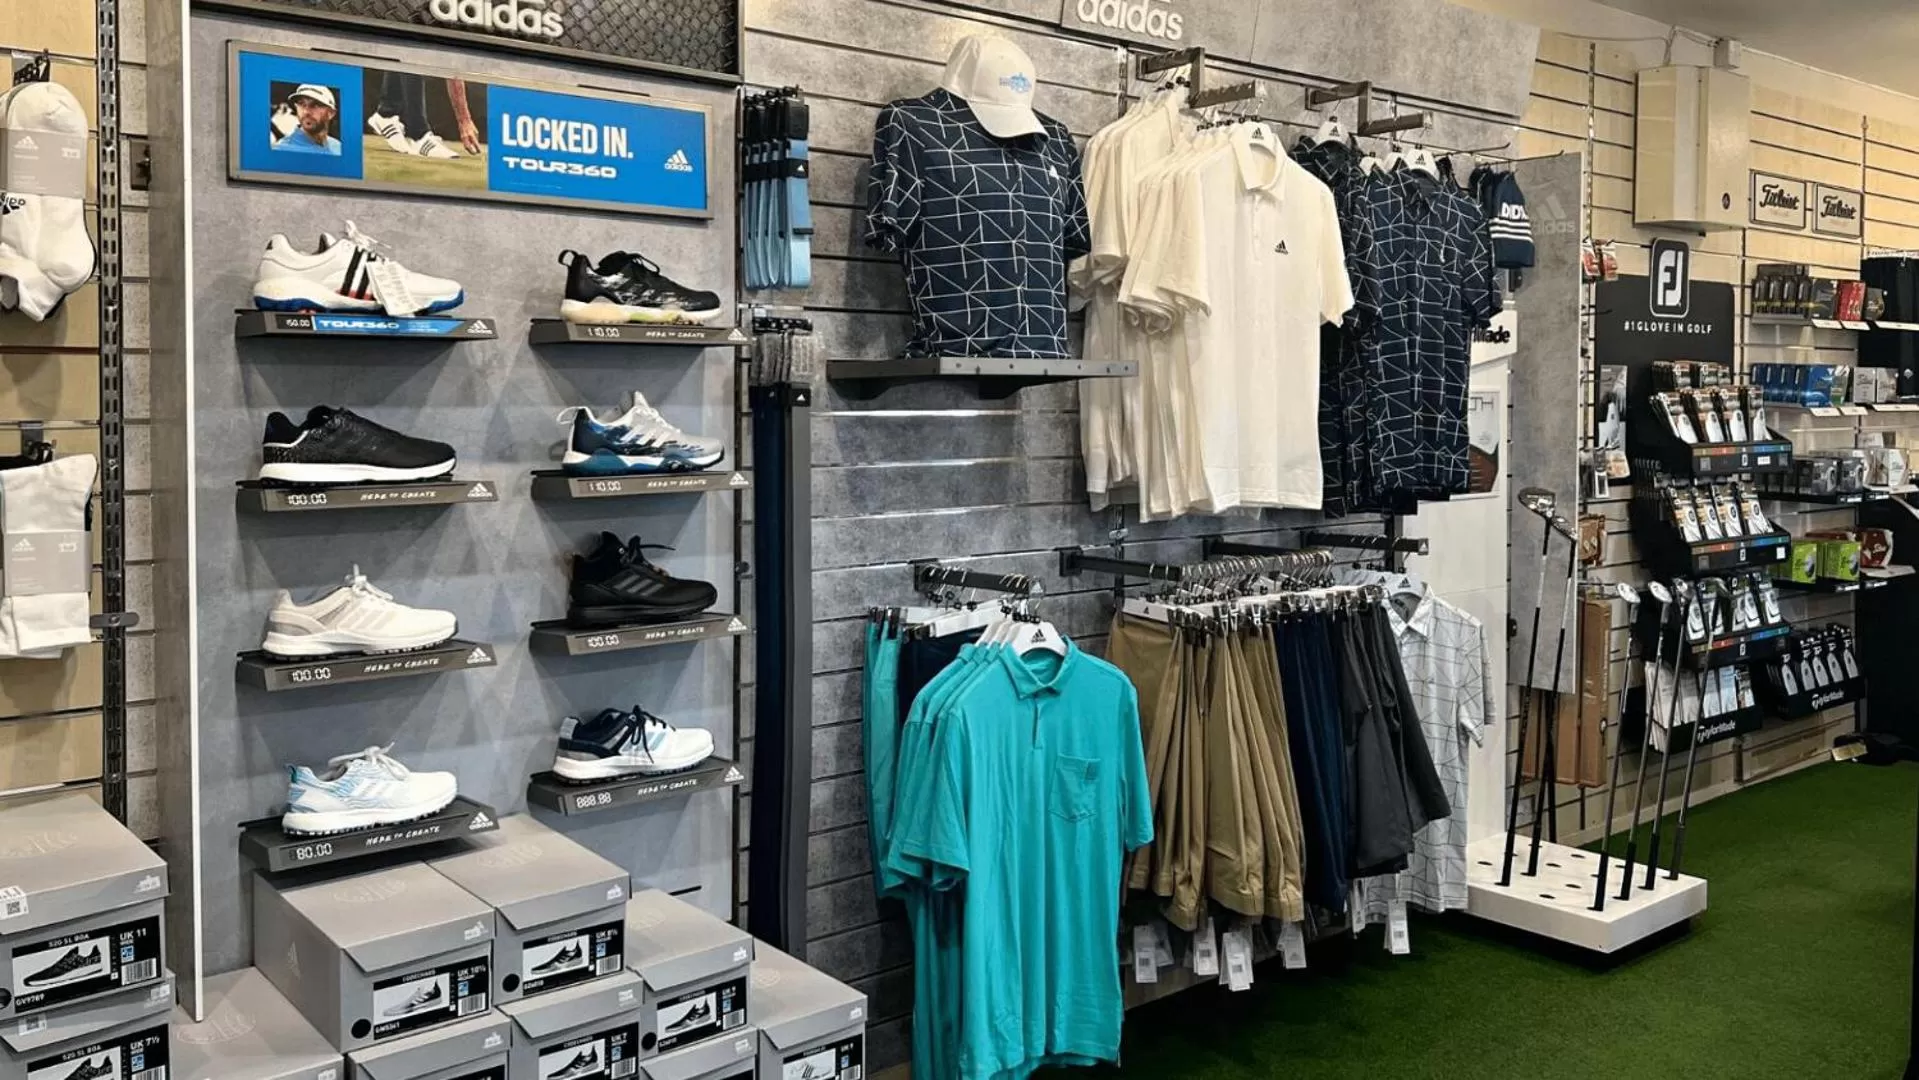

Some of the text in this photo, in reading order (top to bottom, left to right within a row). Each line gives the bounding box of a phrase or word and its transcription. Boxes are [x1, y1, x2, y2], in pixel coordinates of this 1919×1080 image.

[429, 0, 564, 38] adidas
[1077, 0, 1184, 40] adidas
[502, 113, 634, 159] LOCKED IN.
[502, 156, 617, 179] TOUR360
[1657, 249, 1684, 306] FJ
[319, 318, 400, 330] TOUR360
[1637, 321, 1670, 333] GLOVE
[1672, 322, 1684, 333] IN
[1687, 323, 1712, 334] GOLF
[288, 493, 327, 506] 100.00
[291, 667, 331, 682] 100.00
[296, 842, 333, 861] 80.00
[119, 927, 147, 941] UK 11
[130, 1041, 144, 1050] UK
